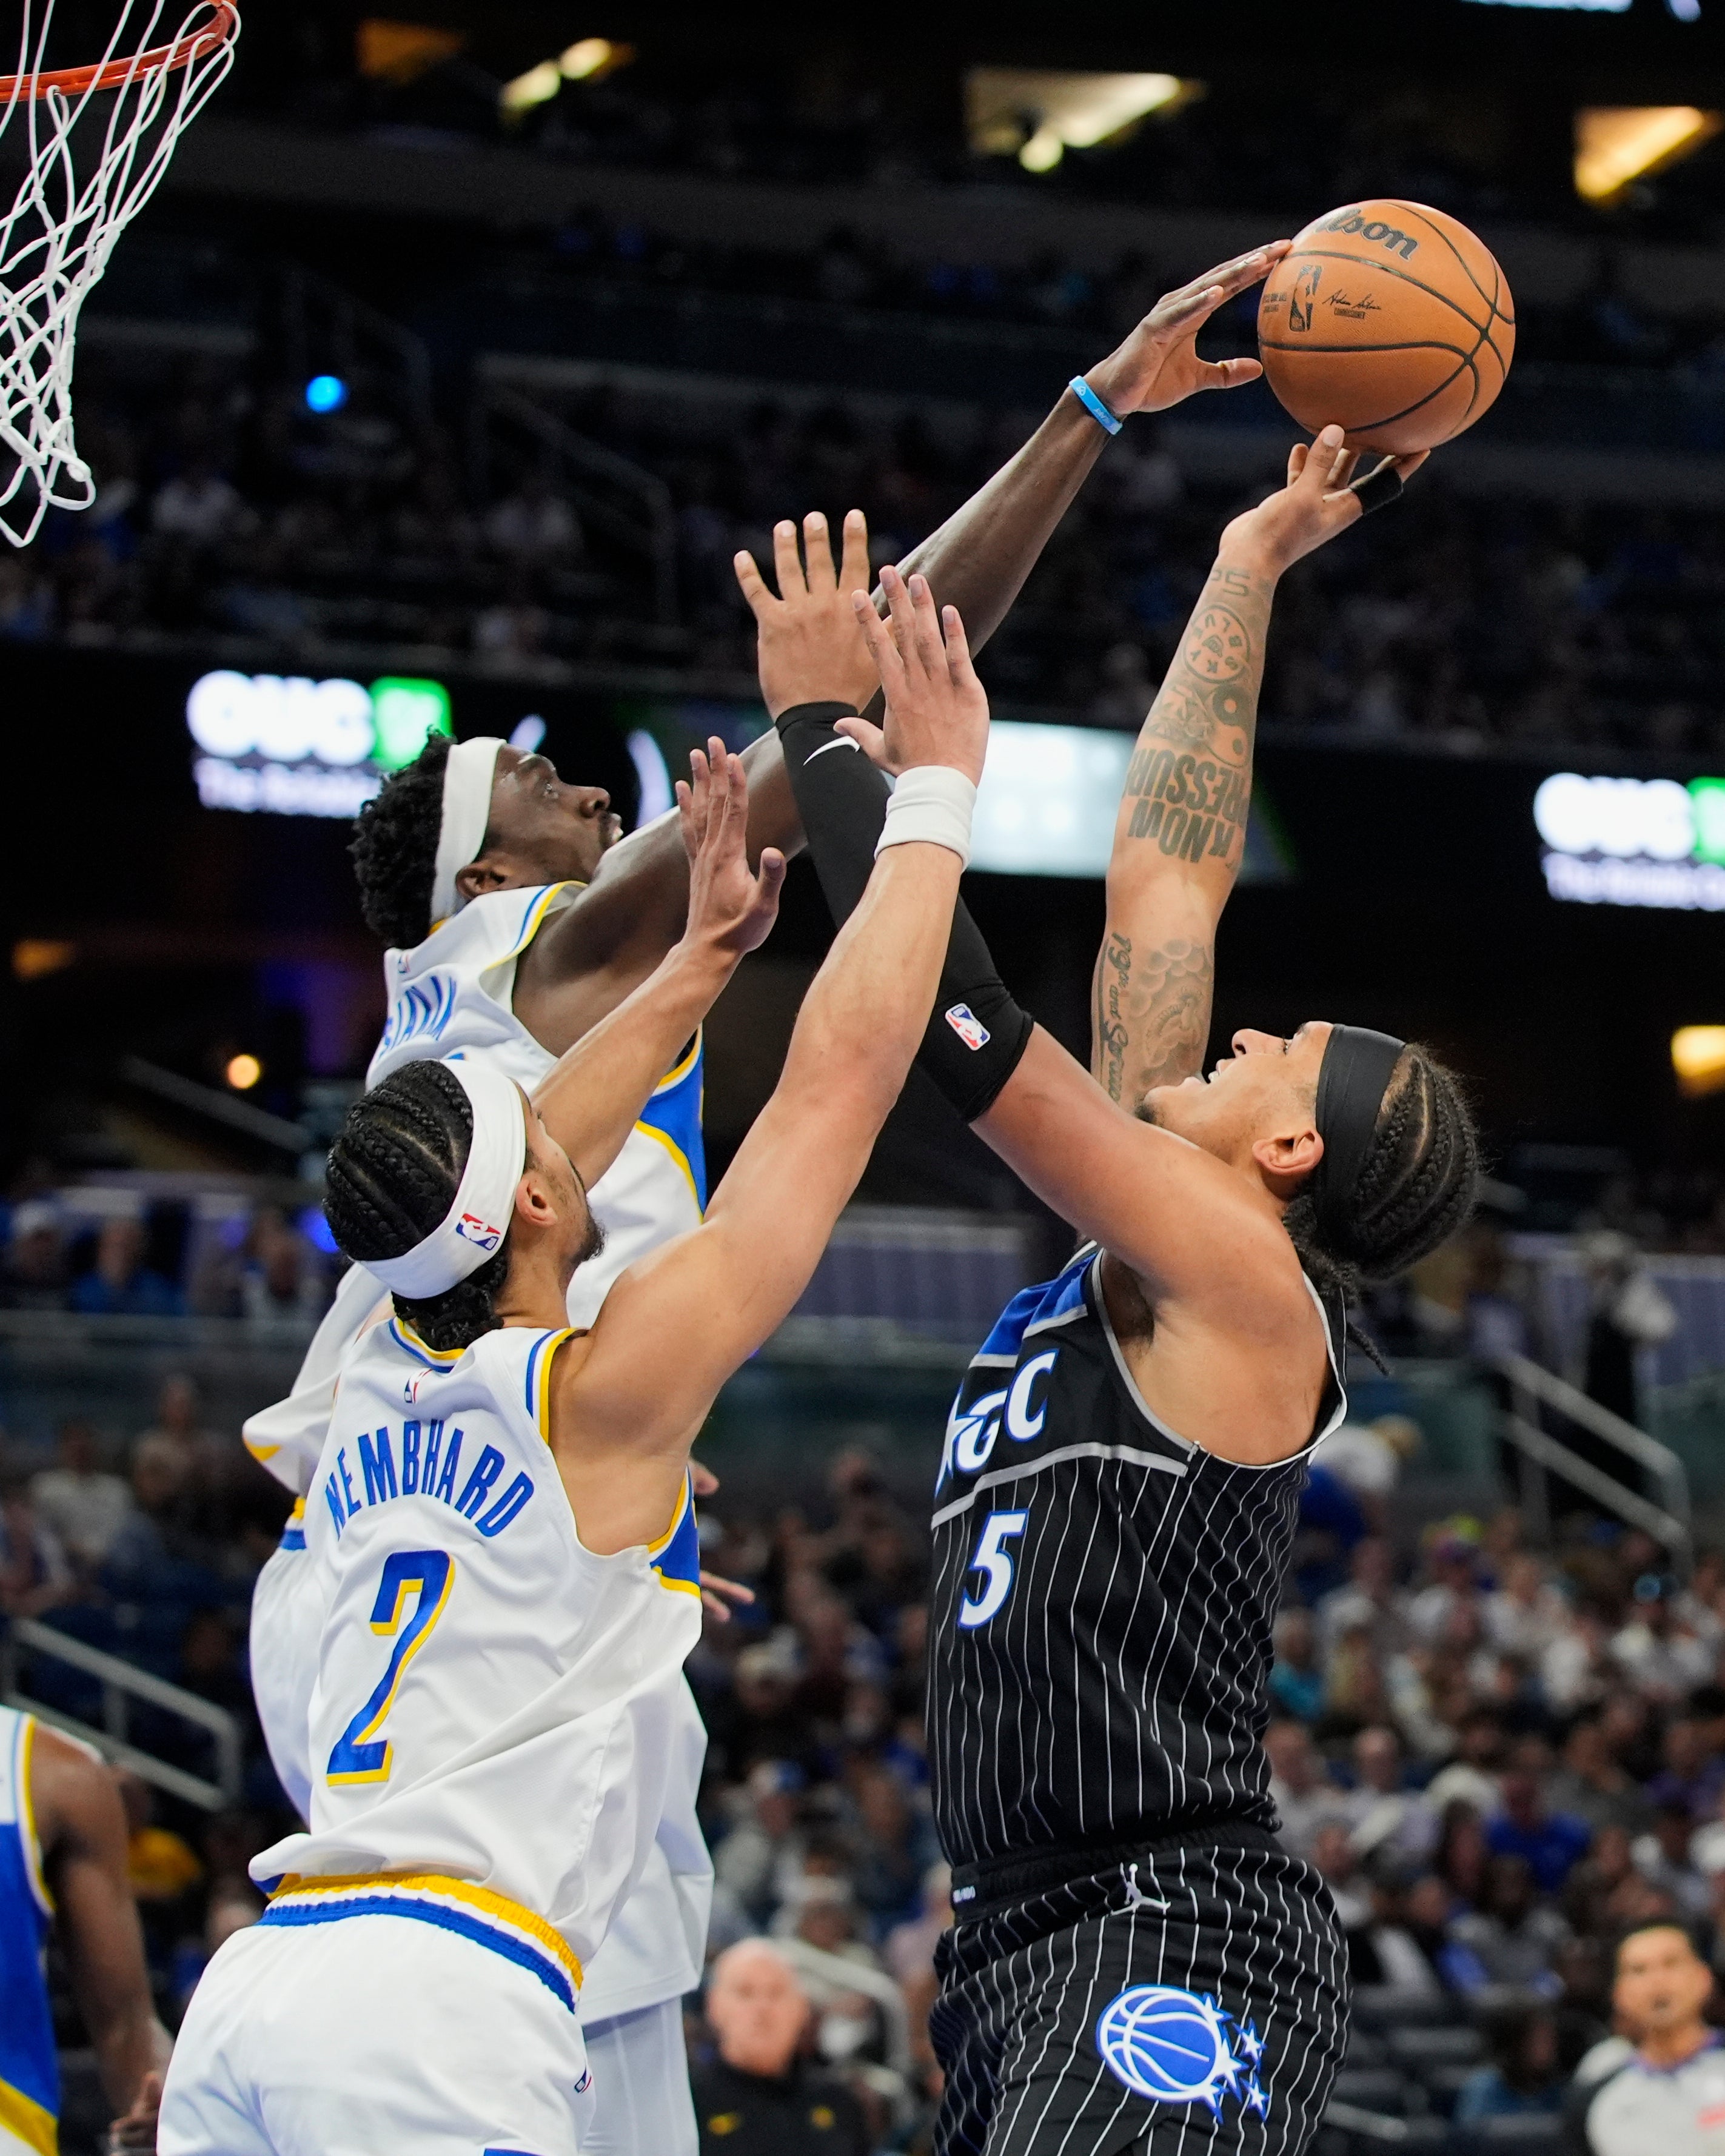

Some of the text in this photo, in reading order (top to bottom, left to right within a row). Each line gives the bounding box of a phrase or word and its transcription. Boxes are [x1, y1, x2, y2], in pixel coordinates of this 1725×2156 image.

[1314, 207, 1419, 261] lson
[1125, 749, 1246, 828] PRESSUR
[1128, 799, 1235, 863] KNOW
[326, 1419, 534, 1541] NEMBHARD
[957, 1508, 1030, 1627] 5
[326, 1550, 455, 1786] 2
